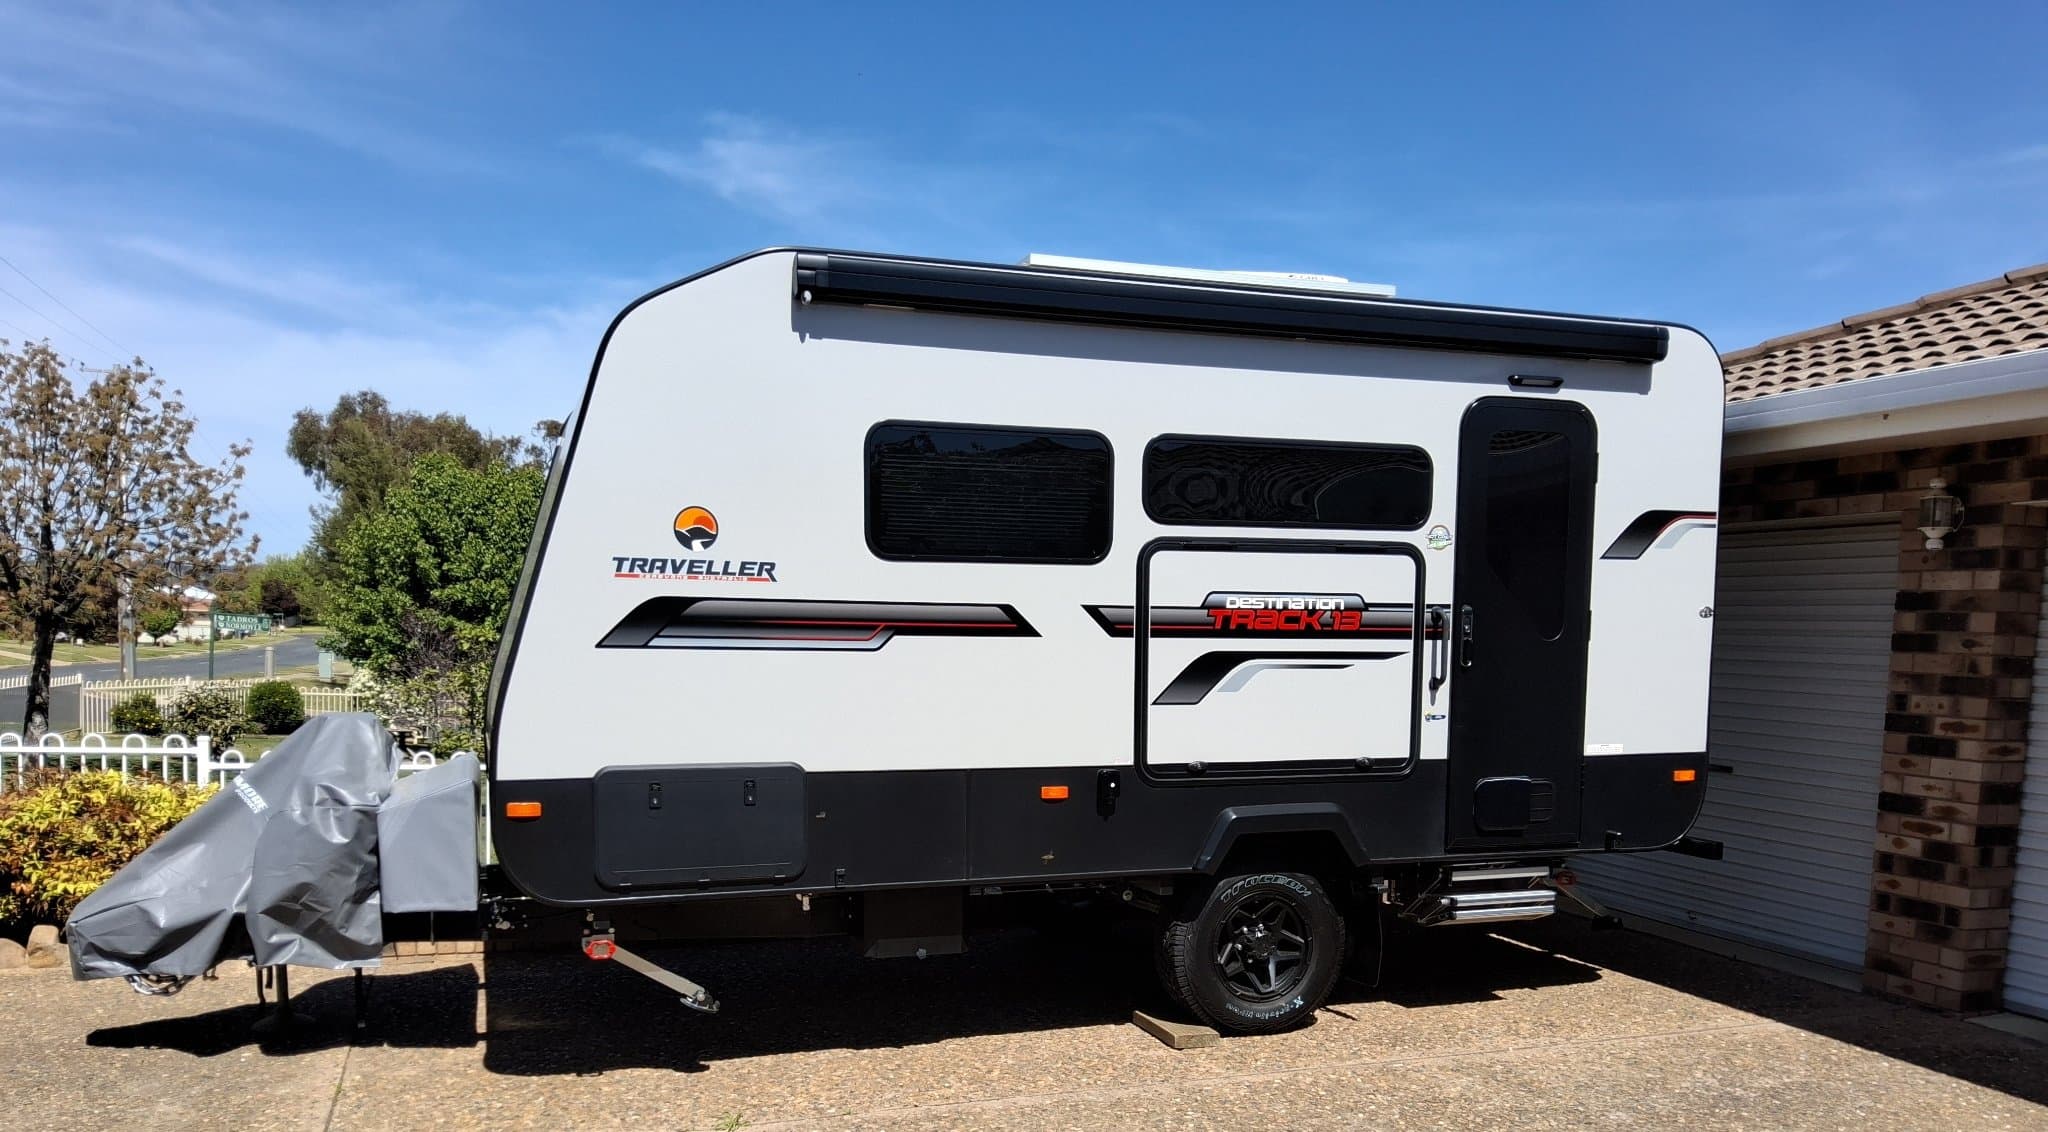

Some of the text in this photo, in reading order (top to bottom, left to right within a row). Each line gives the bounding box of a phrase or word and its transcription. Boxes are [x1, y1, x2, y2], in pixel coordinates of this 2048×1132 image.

[612, 556, 778, 582] TRAVELLER
[226, 615, 258, 624] TADROS
[1208, 608, 1362, 631] TRACK 13
